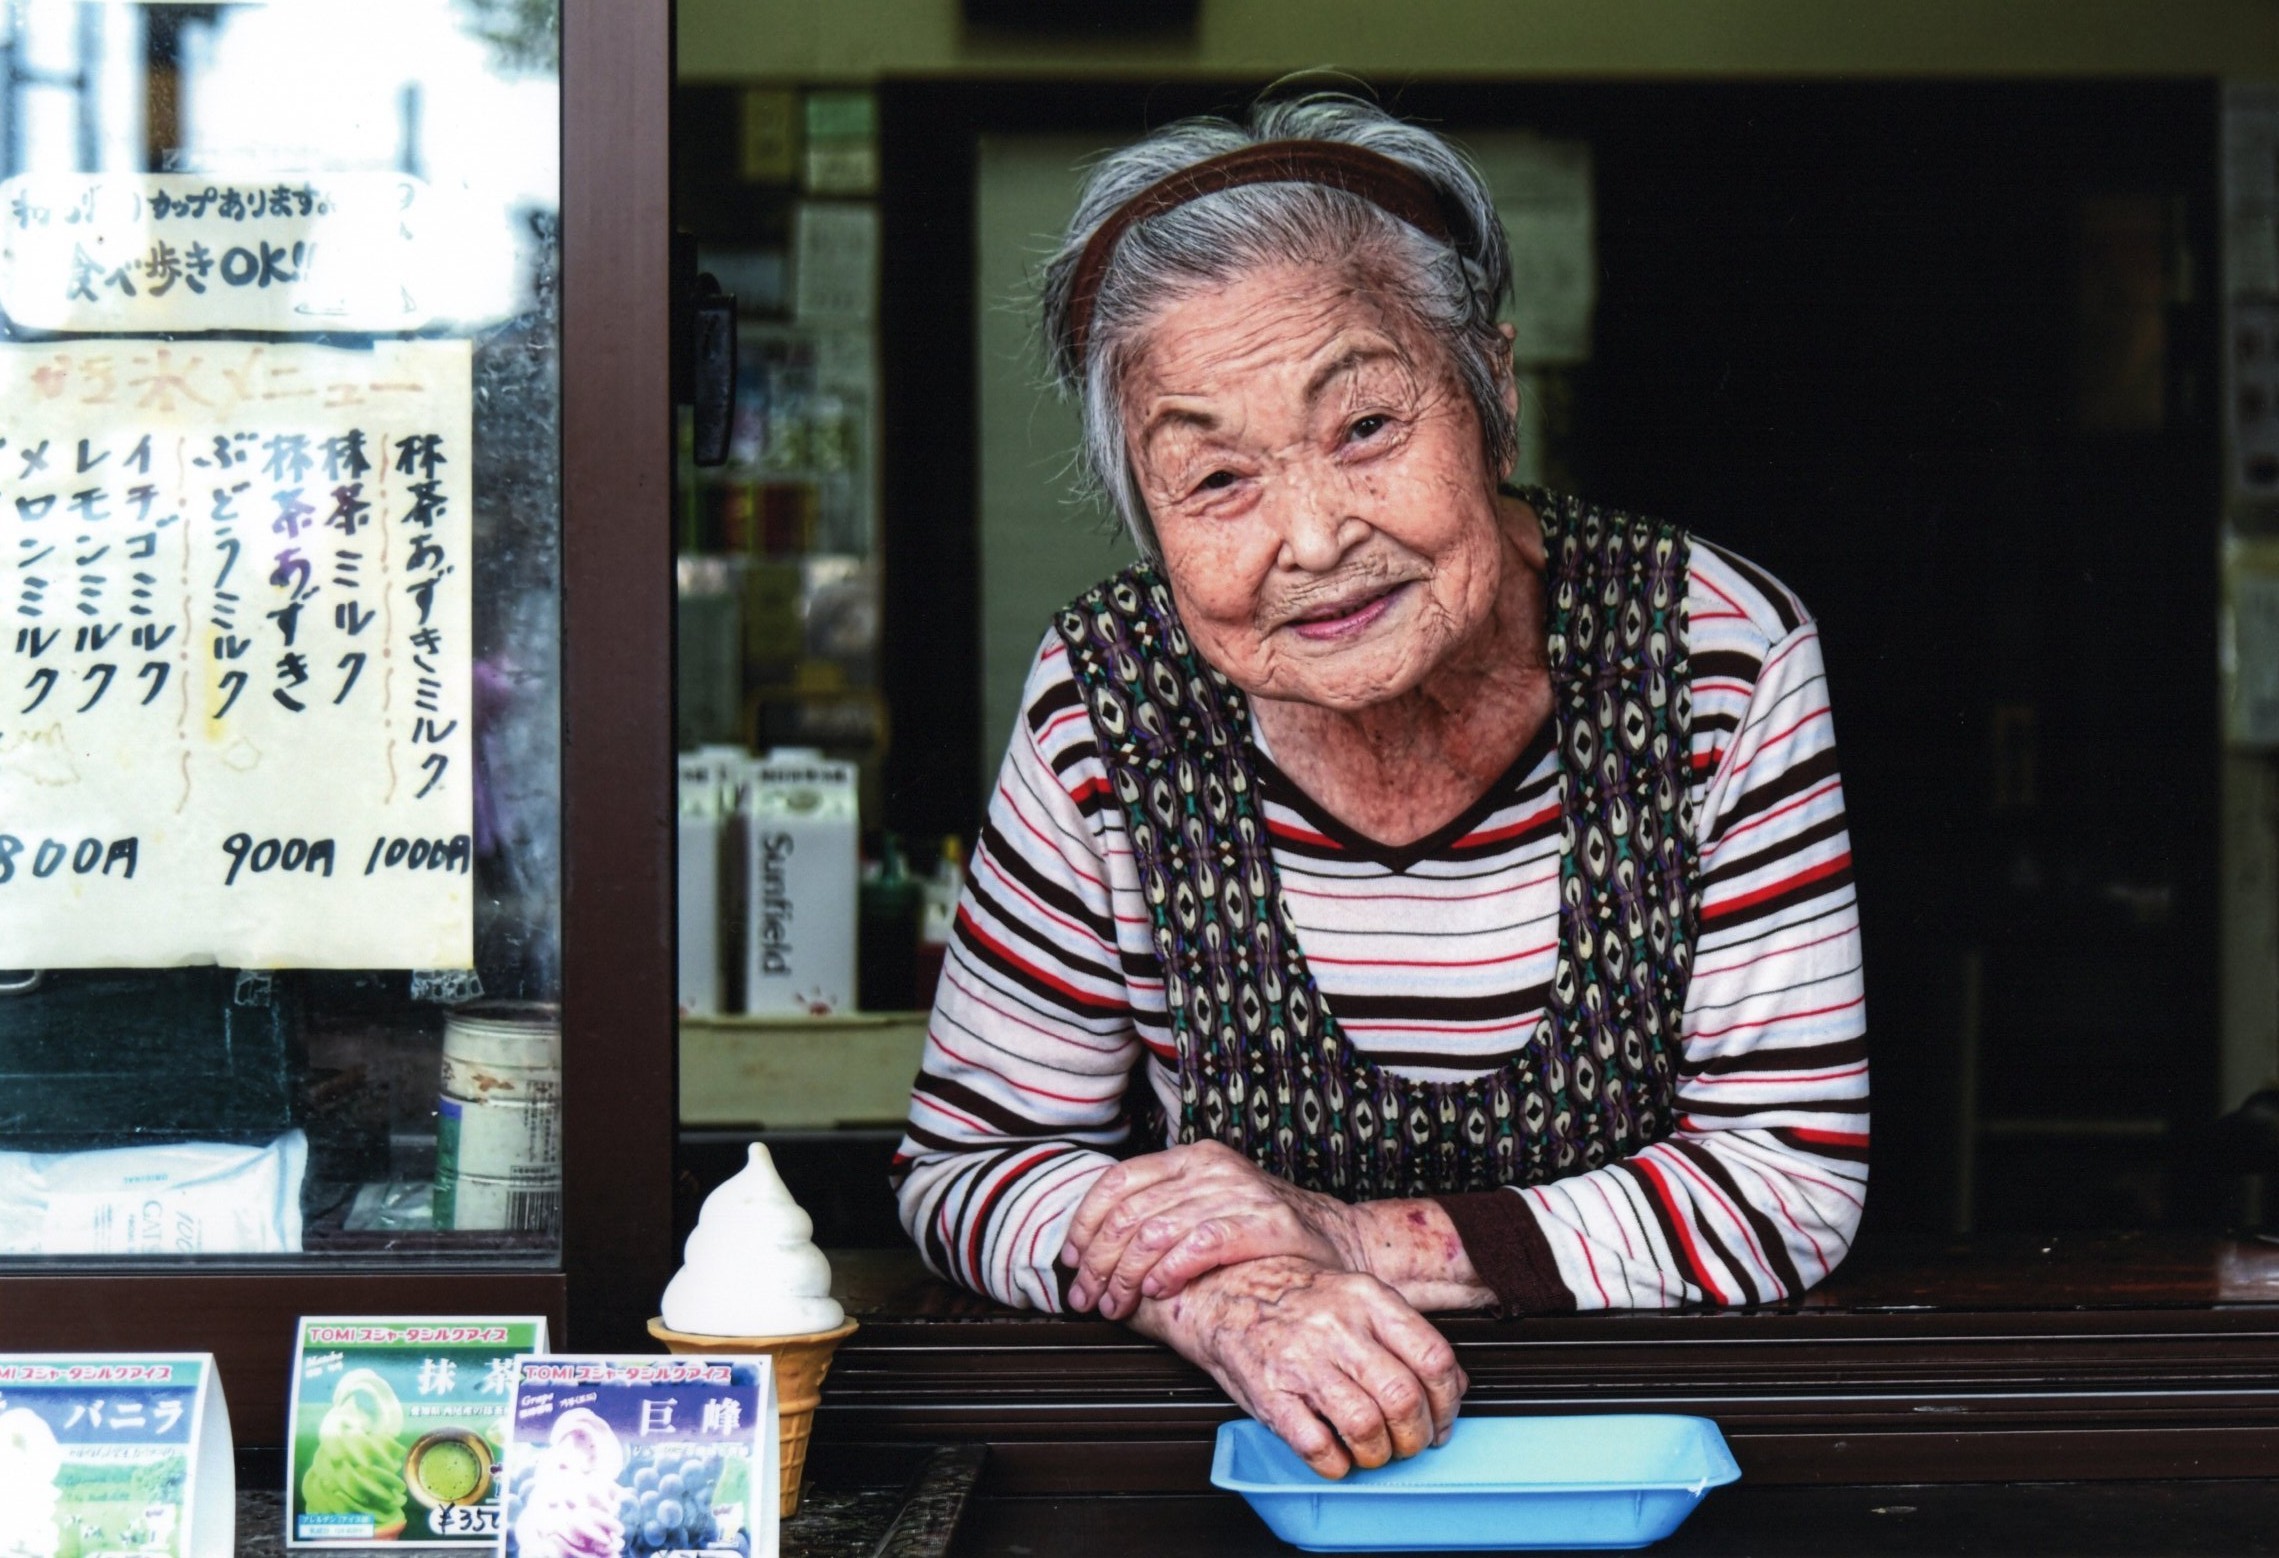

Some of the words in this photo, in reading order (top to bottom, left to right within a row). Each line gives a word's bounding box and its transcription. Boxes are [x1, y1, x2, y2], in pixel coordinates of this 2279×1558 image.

[15, 439, 62, 714] メロンミルク
[67, 438, 123, 713] レモンミルク
[122, 434, 180, 705] イチゴミルク
[192, 432, 259, 719] ぶどうミルク
[763, 832, 794, 978] Sunfield
[310, 1328, 356, 1341] TOMI
[417, 1357, 512, 1395] 抹茶
[525, 1366, 573, 1380] TOMI
[64, 1400, 184, 1435] バニラ
[640, 1397, 743, 1437] 巨峰
